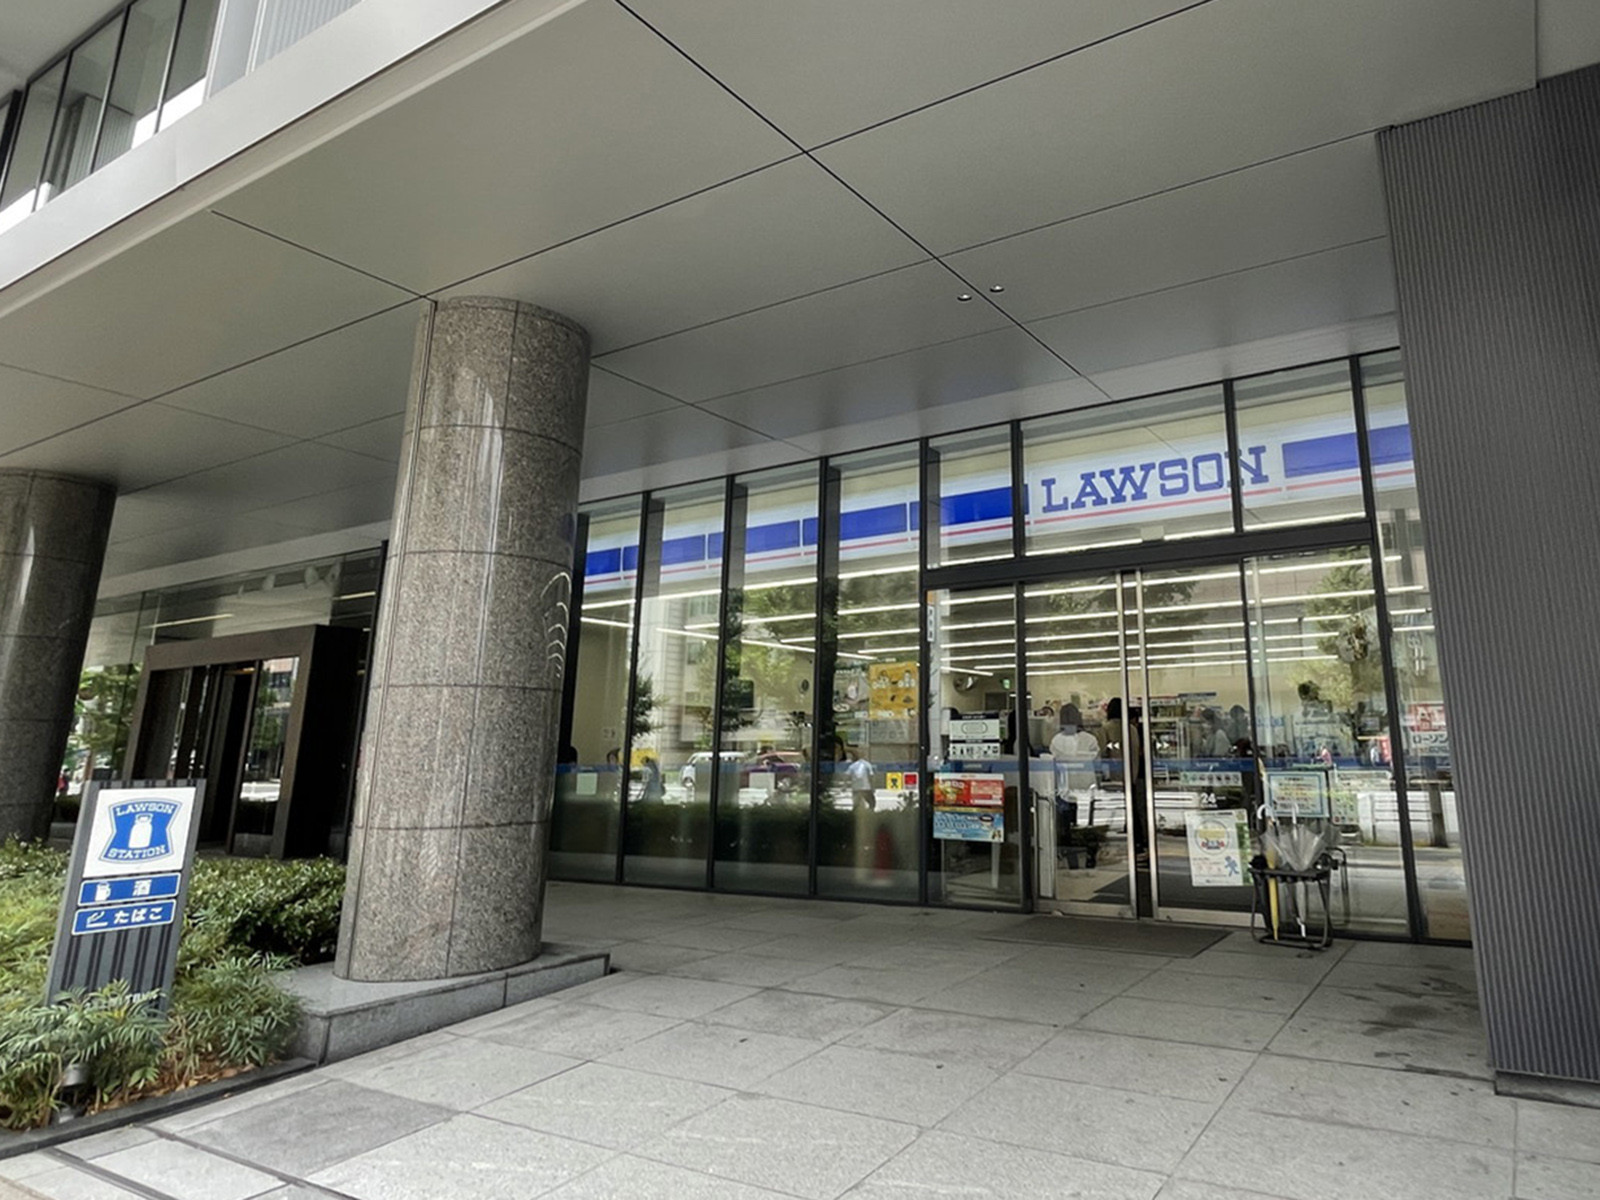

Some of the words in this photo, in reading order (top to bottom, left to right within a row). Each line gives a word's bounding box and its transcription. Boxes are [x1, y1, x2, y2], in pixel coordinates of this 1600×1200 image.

[116, 802, 174, 816] LAWSON
[108, 844, 166, 859] STATION
[132, 879, 152, 896] 酒
[114, 907, 163, 924] たばこ
